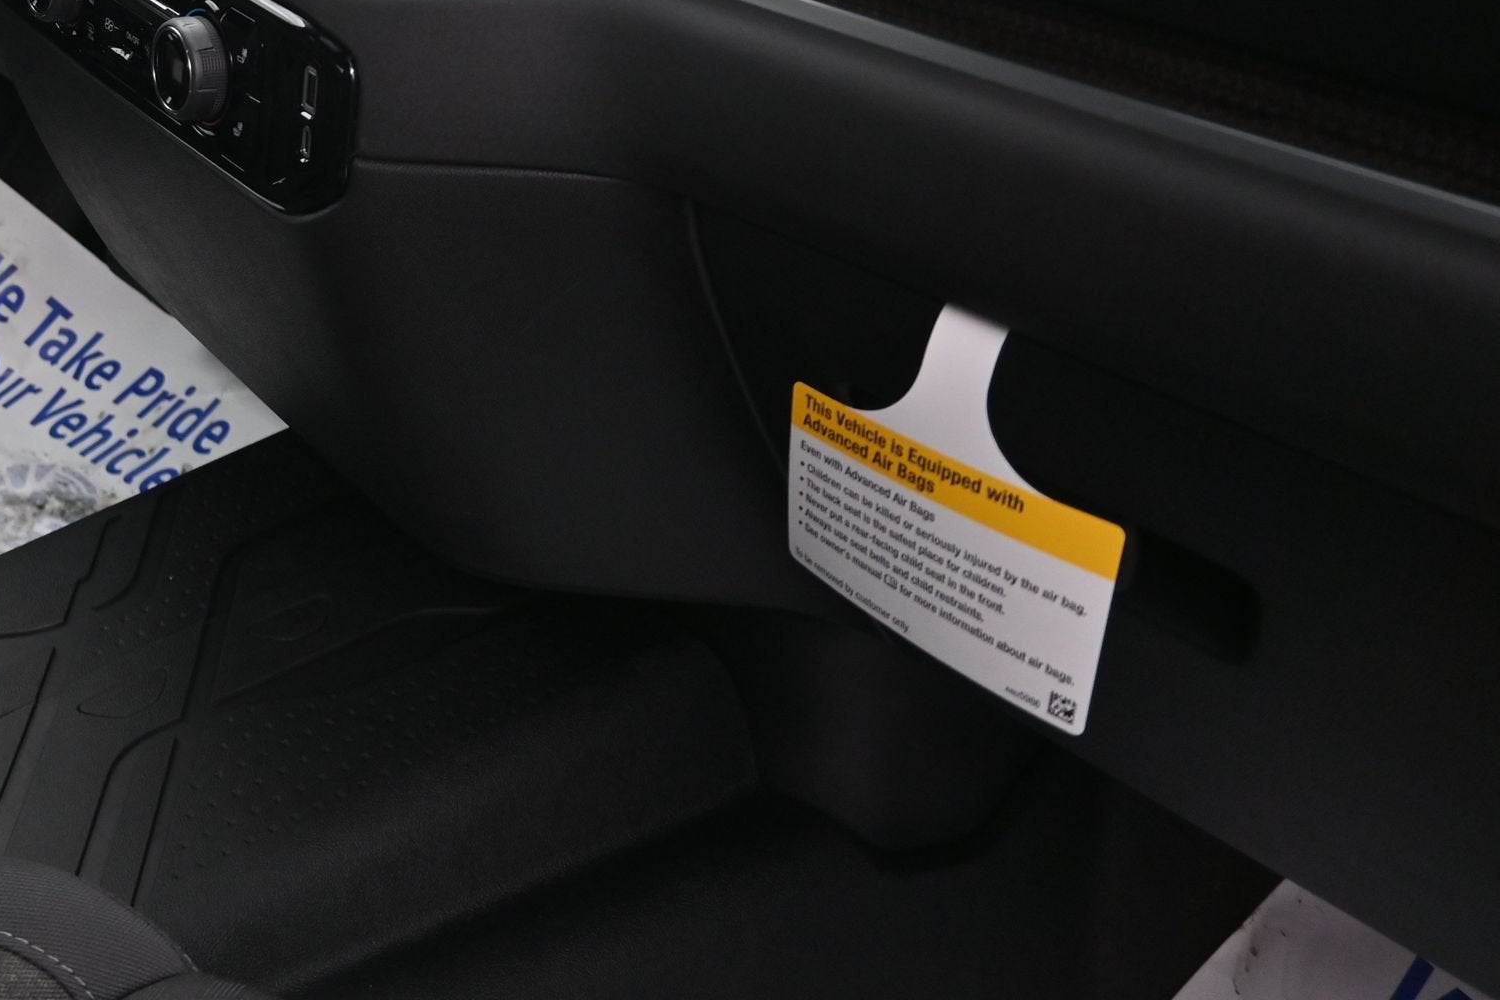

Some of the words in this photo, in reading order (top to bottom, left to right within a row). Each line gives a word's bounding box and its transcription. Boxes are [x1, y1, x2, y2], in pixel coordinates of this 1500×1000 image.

[24, 296, 121, 391] Take
[113, 366, 231, 455] Pride
[800, 439, 821, 460] Even
[823, 454, 843, 472] with
[844, 466, 891, 499] Advanced
[893, 492, 907, 507] Air
[909, 500, 936, 523] Bags
[803, 412, 869, 460] Advanced
[872, 450, 894, 472] Air
[896, 461, 936, 495] Bags
[805, 393, 833, 421] This
[836, 410, 887, 449] Vehicle
[891, 438, 904, 458] is
[907, 446, 982, 495] Equipped
[986, 485, 1025, 514] with
